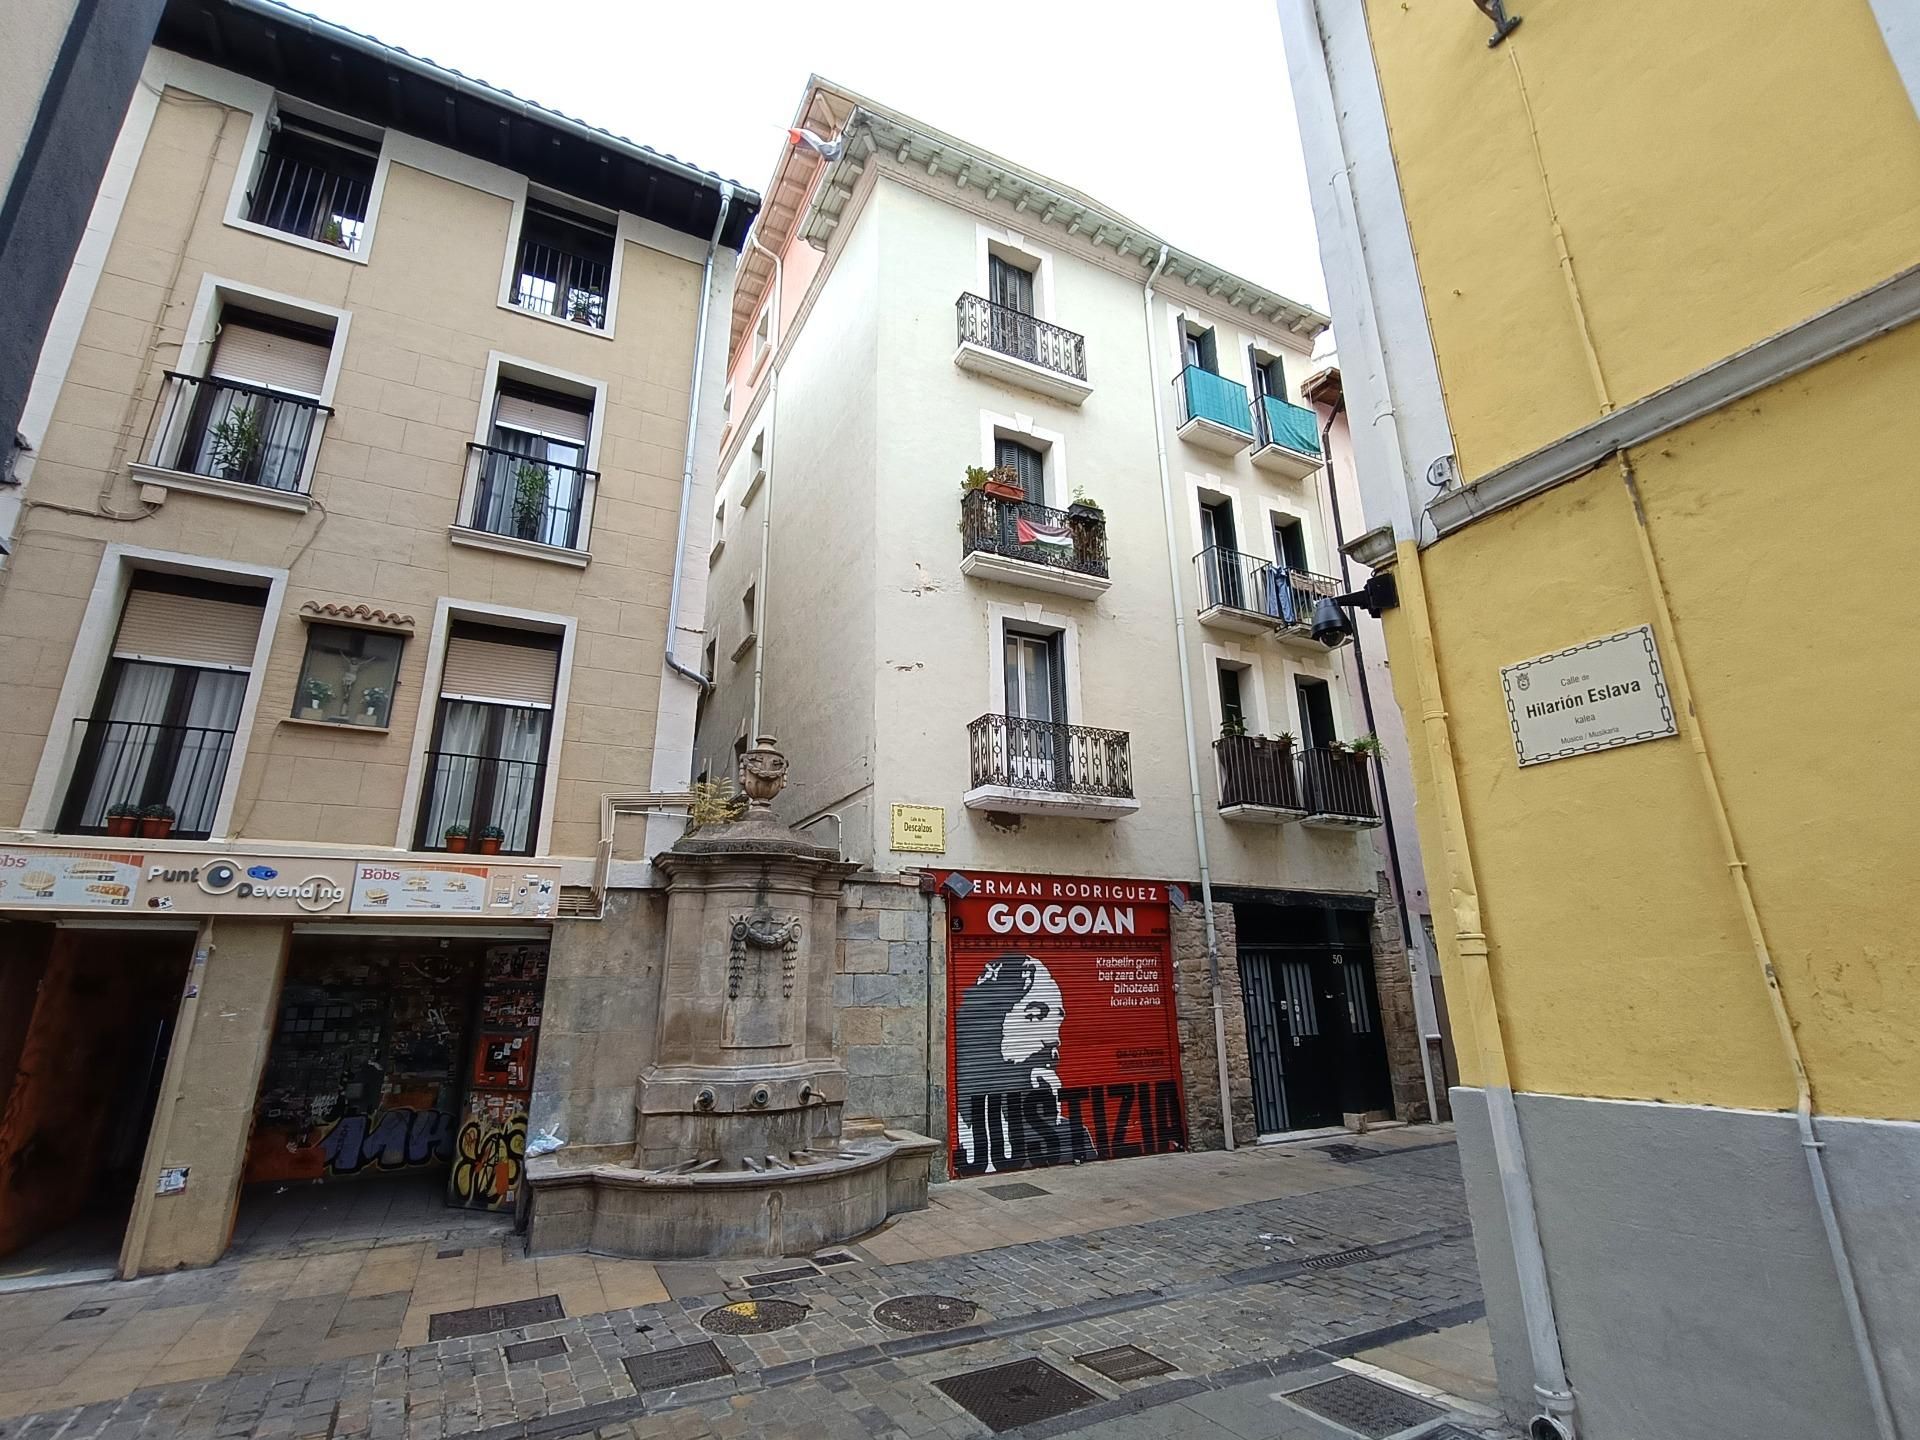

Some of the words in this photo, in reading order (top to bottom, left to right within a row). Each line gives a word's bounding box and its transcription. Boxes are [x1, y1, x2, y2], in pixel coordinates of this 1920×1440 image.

[1560, 675, 1580, 687] Calle
[1581, 674, 1591, 682] de
[1526, 694, 1584, 719] Hilarión
[1587, 680, 1641, 703] Eslava
[1574, 713, 1596, 725] kalea
[904, 821, 933, 833] Descalzos
[360, 868, 400, 881] Bobs
[237, 882, 346, 904] Devending
[973, 879, 1042, 896] ERMAN
[1053, 883, 1158, 901] RODRIGUEZ
[987, 903, 1136, 935] GOGOAN
[1332, 954, 1343, 965] 50
[1098, 971, 1113, 981] bat
[957, 1079, 1182, 1171] JUSTIZIA
